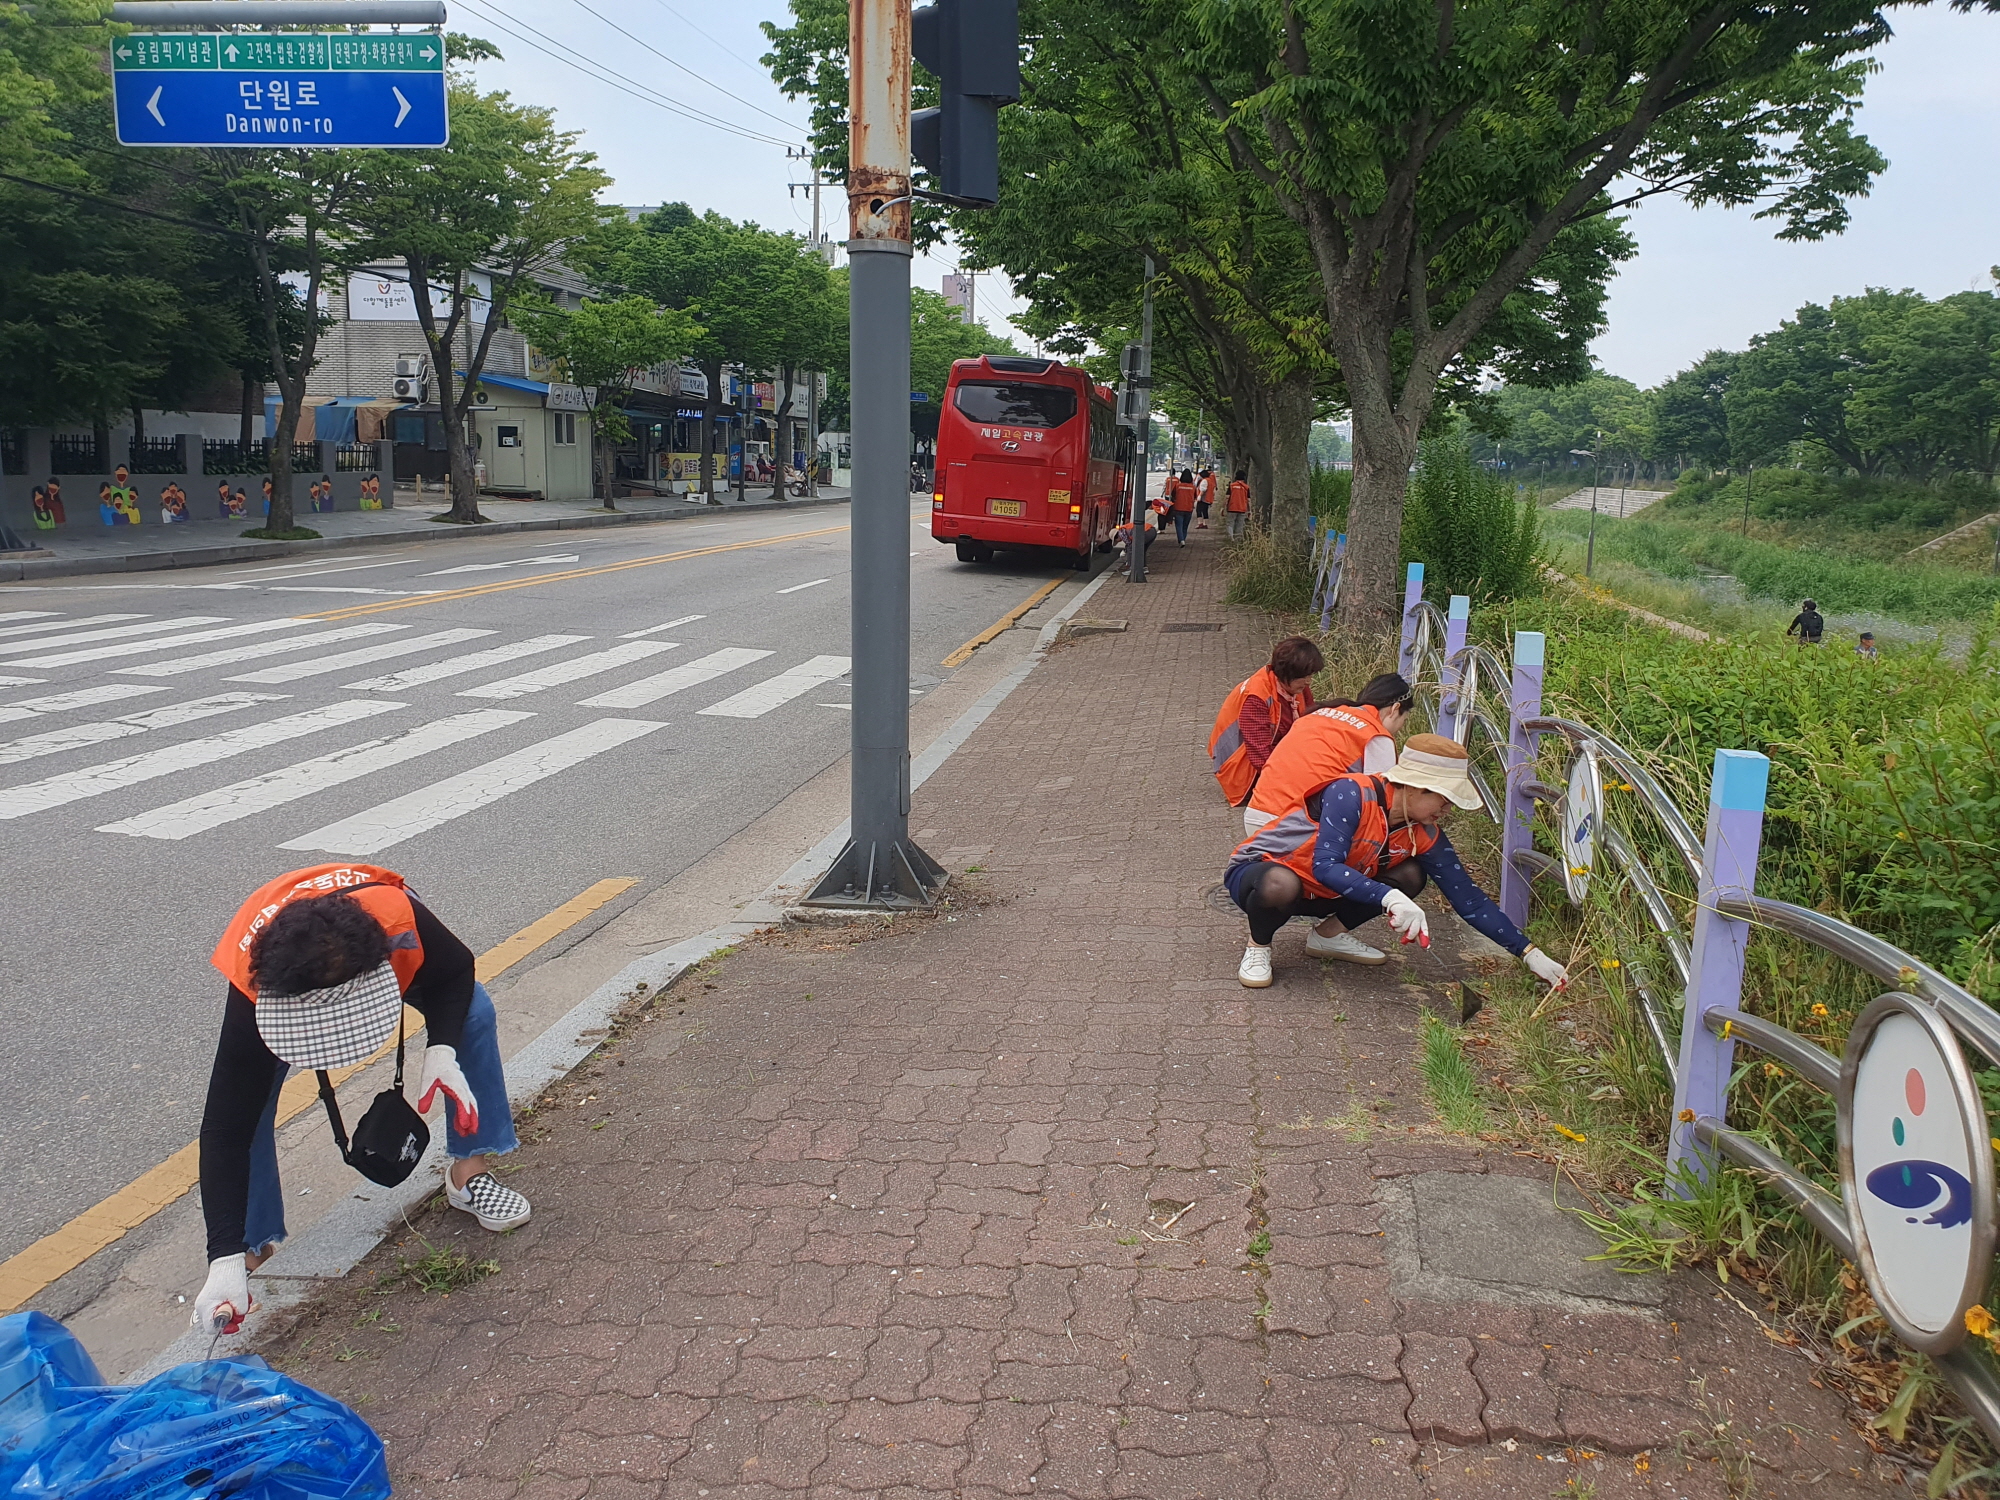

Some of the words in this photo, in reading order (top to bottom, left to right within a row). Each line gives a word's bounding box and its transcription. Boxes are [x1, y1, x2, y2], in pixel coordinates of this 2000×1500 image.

[137, 41, 212, 65] 올림픽기념관
[240, 80, 320, 111] 단원로
[226, 113, 333, 134] Danwon-ro
[981, 428, 1044, 442] 제일고속관광
